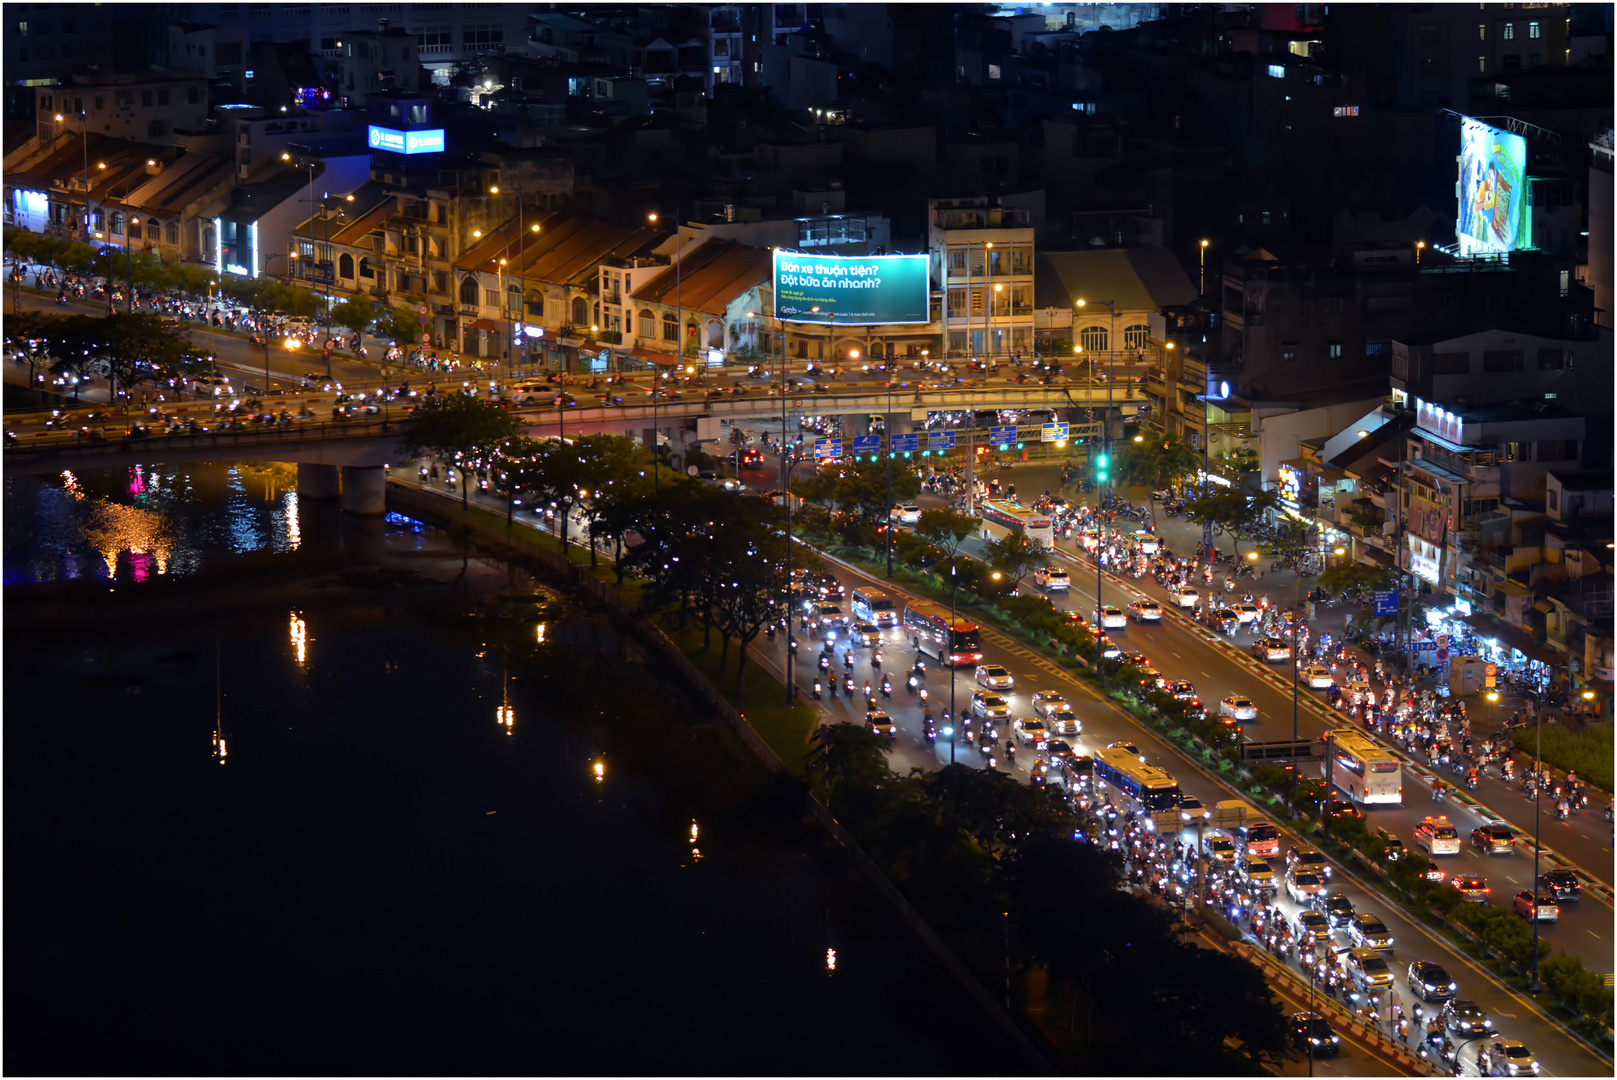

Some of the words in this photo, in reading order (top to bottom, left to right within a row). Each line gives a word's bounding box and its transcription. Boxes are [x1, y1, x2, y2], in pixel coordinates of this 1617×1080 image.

[781, 261, 800, 272] Đón
[801, 265, 814, 274] xe
[815, 264, 848, 277] thuận
[849, 265, 879, 277] tiện?
[781, 275, 798, 287] Đặt
[799, 276, 820, 287] bữa
[821, 277, 836, 288] ăn
[838, 278, 881, 289] nhanh?
[780, 305, 797, 315] Grab
